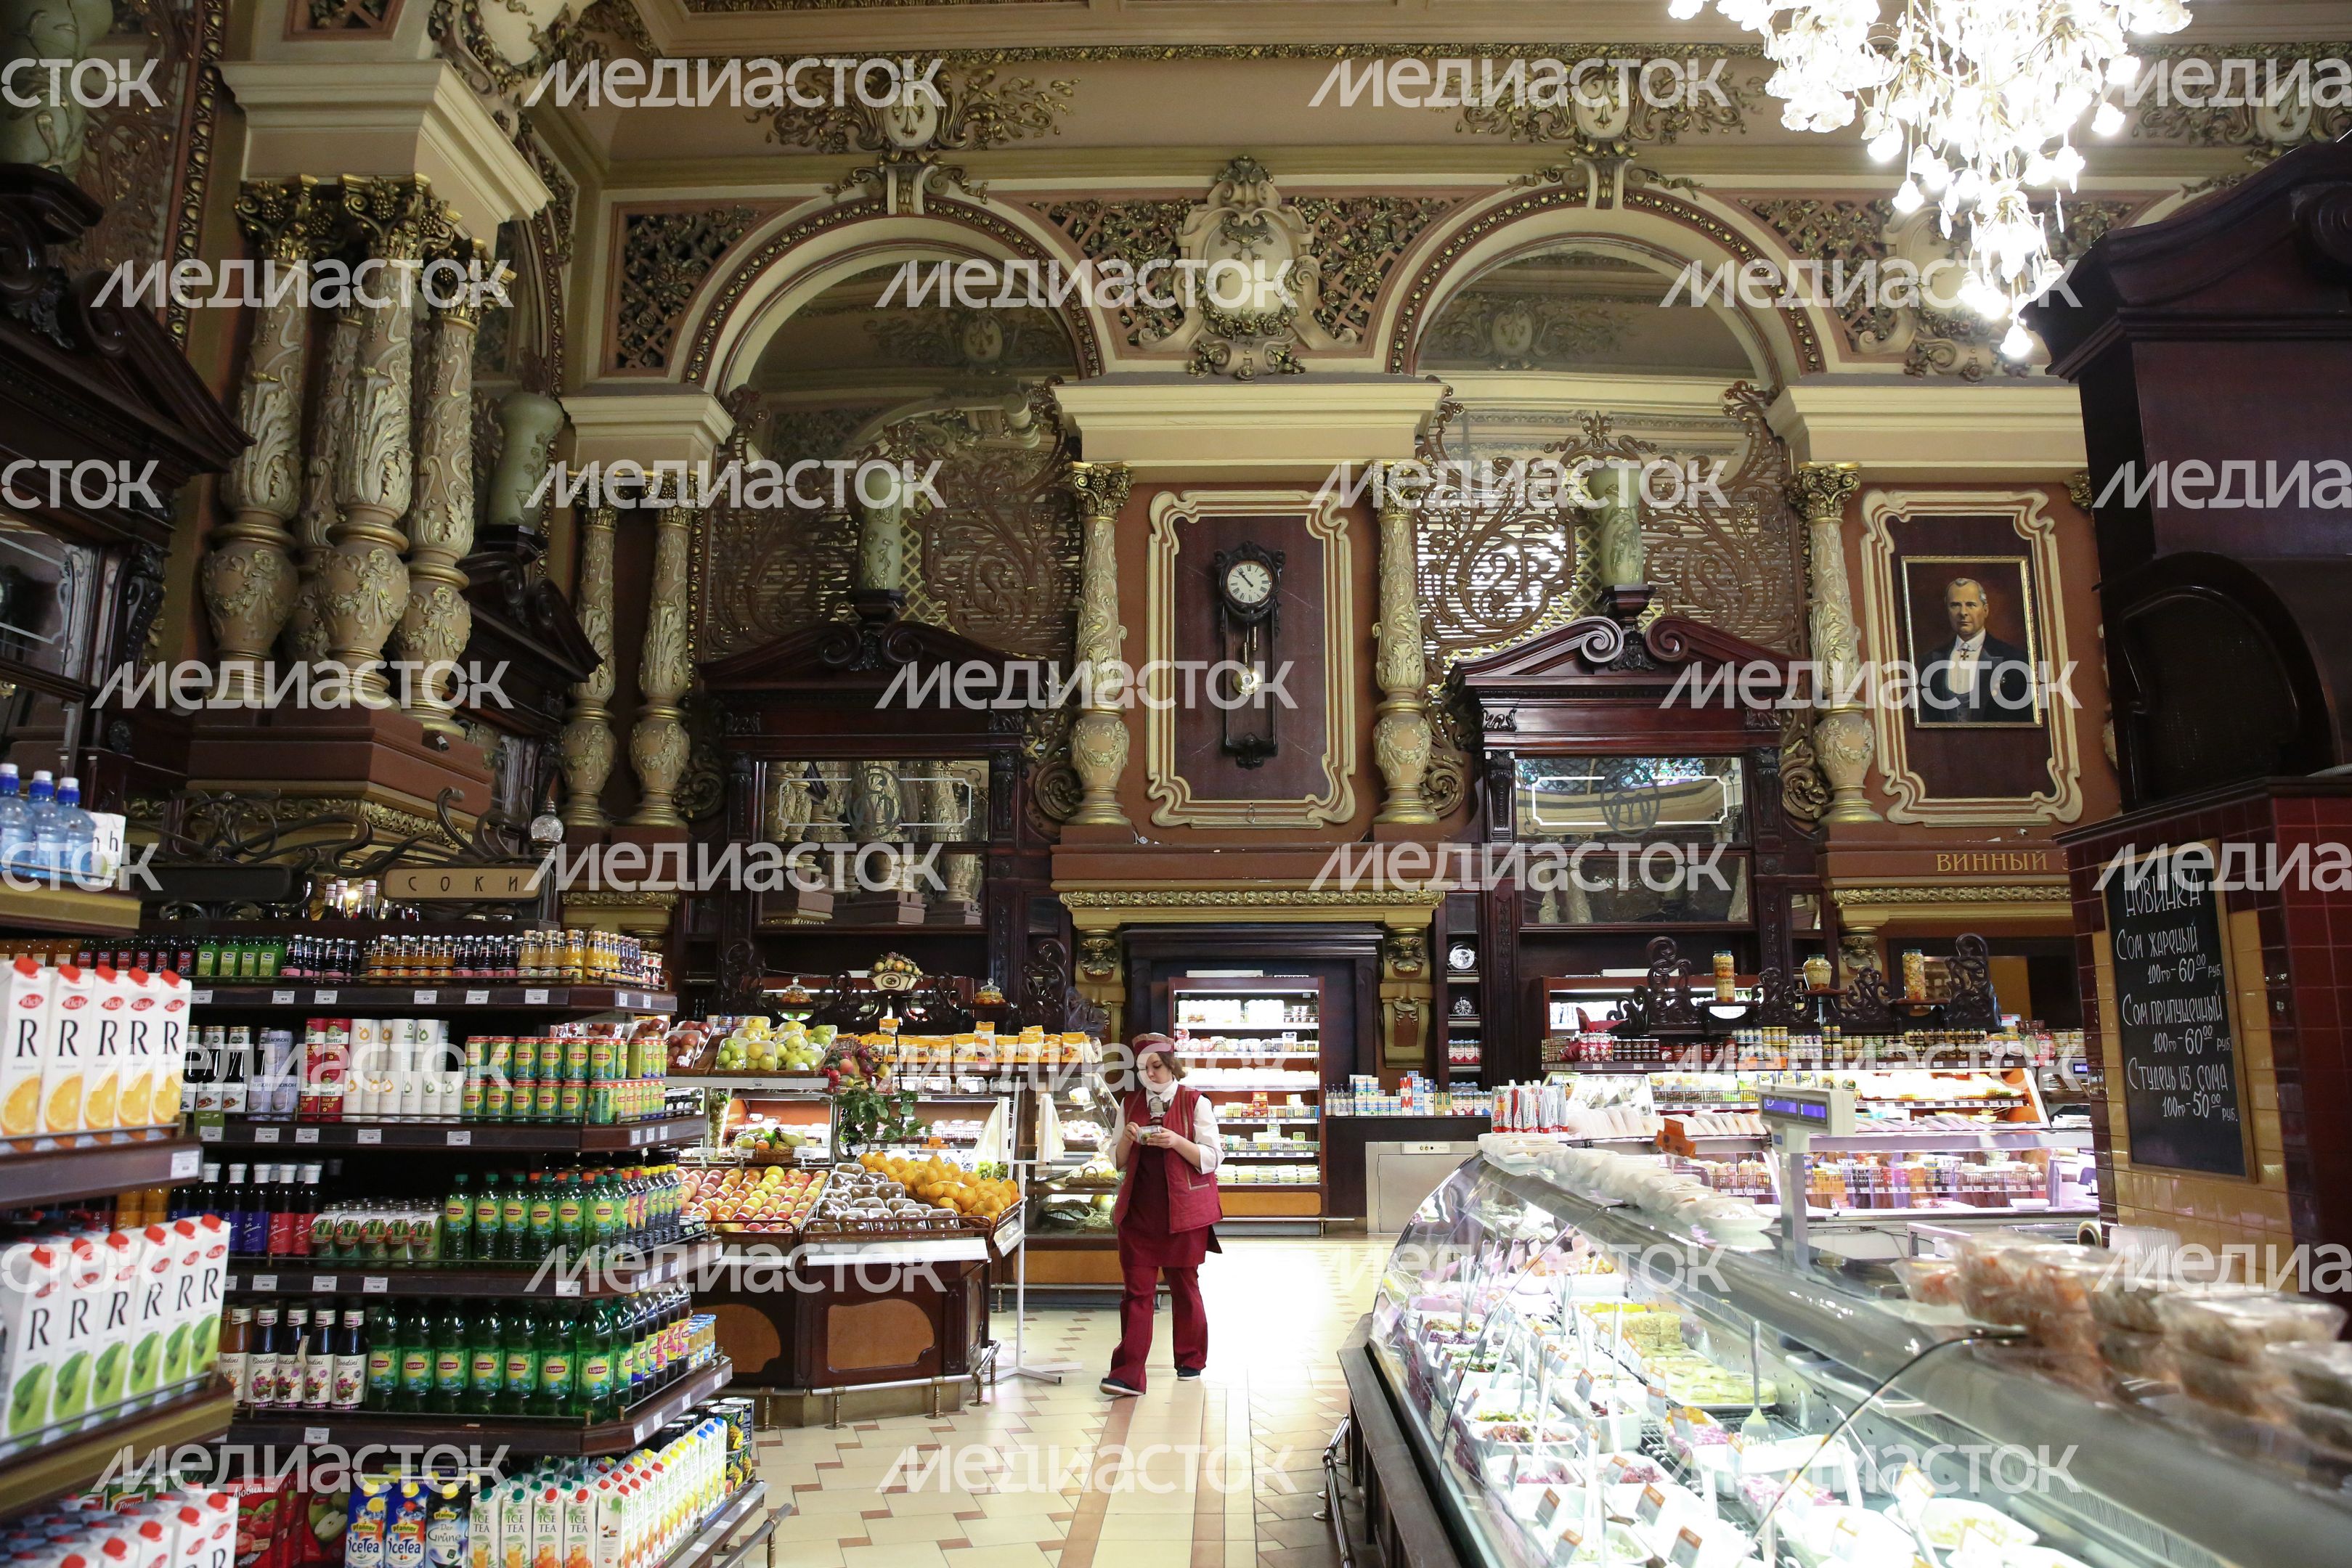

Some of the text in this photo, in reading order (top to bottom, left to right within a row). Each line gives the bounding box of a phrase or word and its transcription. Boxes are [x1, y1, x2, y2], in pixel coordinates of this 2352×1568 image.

[1936, 851, 2048, 871] ВИННЫЙ
[408, 876, 518, 891] СОКИ
[2123, 868, 2201, 917] НОВИНКА
[17, 1019, 38, 1057] R
[58, 1019, 78, 1056] R
[97, 1020, 118, 1056] R
[130, 1021, 149, 1055] R
[163, 1021, 179, 1055] R
[144, 1282, 163, 1320] R
[176, 1275, 193, 1311] R
[201, 1267, 219, 1304] R
[69, 1298, 89, 1339] R
[107, 1291, 129, 1330] R
[28, 1308, 49, 1351] R
[474, 1515, 490, 1524] ICE
[506, 1524, 524, 1533] TEA
[508, 1514, 524, 1523] ICE
[538, 1524, 556, 1533] TEA
[539, 1514, 556, 1523] ICE
[570, 1524, 588, 1533] TEA
[571, 1514, 587, 1523] ICE
